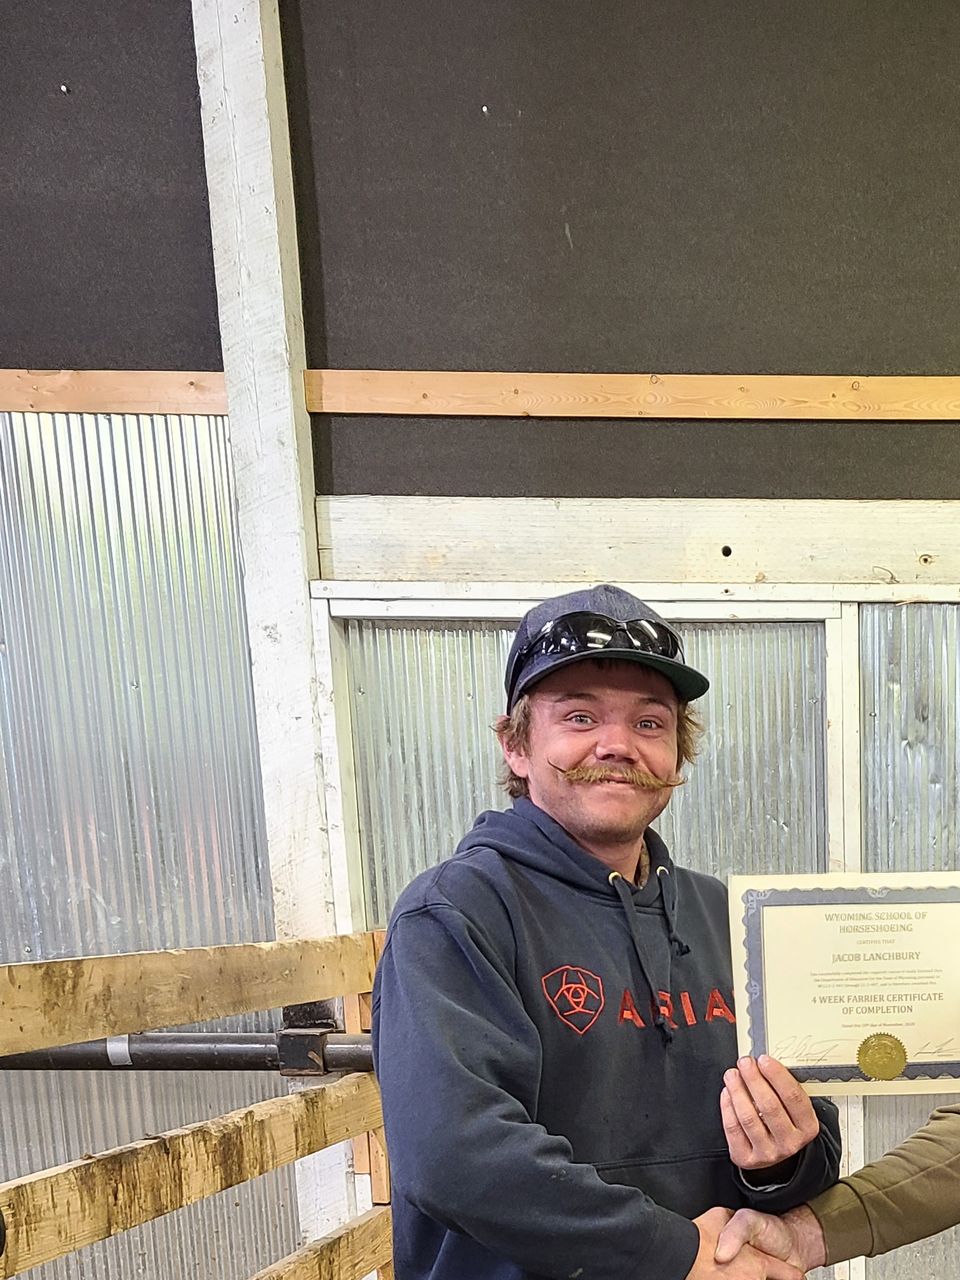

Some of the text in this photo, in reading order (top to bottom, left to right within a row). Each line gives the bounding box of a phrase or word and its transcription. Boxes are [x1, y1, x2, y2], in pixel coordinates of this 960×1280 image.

[824, 911, 928, 922] WYOMING SCHOOL OF
[839, 923, 913, 934] HORSESHOEING
[832, 951, 921, 963] JACOB LANCHBURY
[818, 995, 845, 1004] WEEK
[847, 994, 885, 1003] FARRIER
[886, 992, 944, 1002] CERTIFICATE
[619, 988, 736, 1029] ARIA
[842, 1005, 913, 1015] OF COMPLETION
